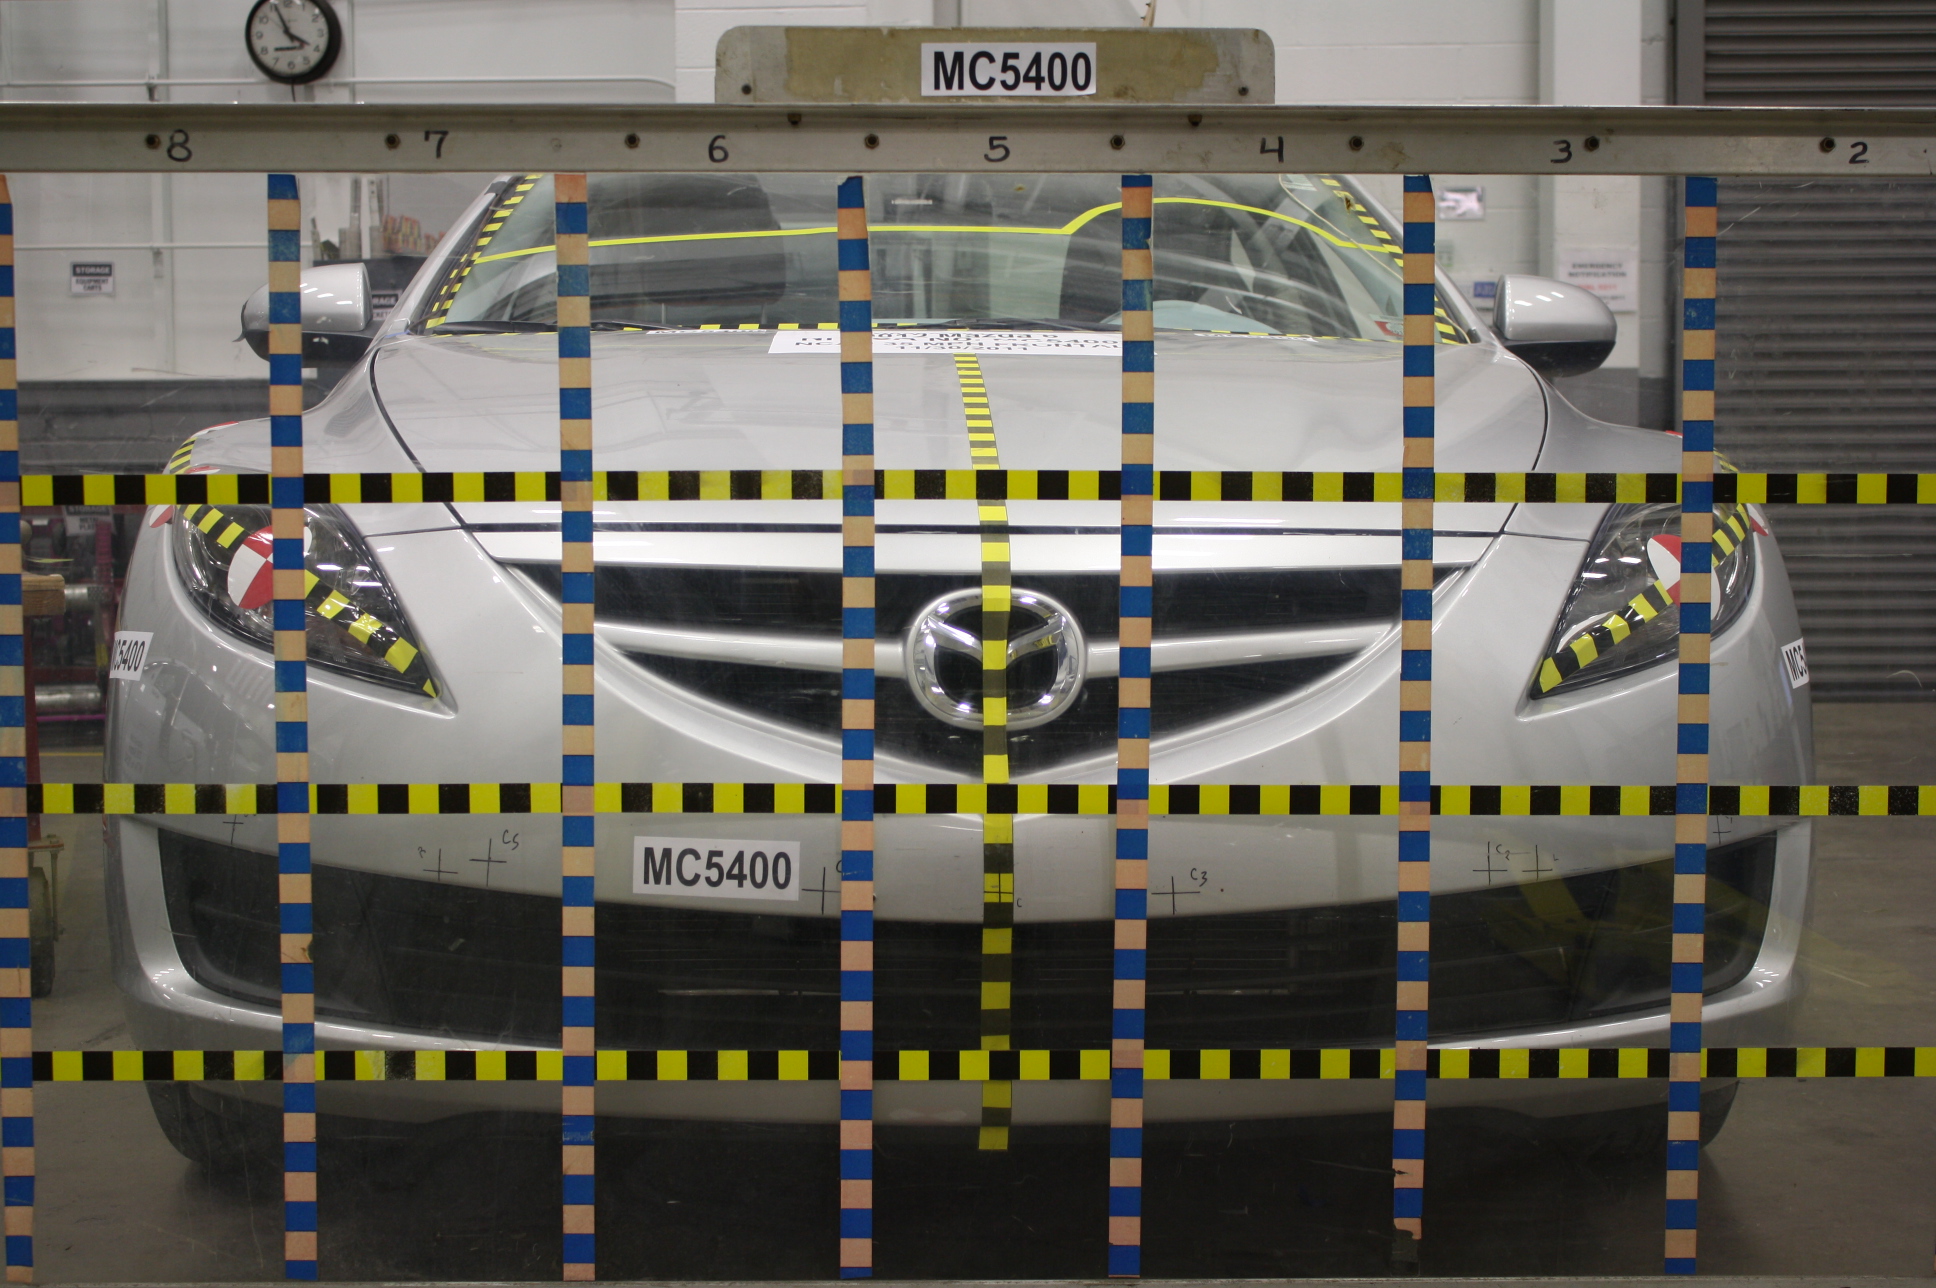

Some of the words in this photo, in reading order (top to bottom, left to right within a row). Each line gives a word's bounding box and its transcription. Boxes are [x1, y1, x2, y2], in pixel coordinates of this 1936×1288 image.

[312, 13, 320, 23] 2
[287, 61, 295, 70] 6
[933, 50, 1092, 92] MC5400
[166, 129, 192, 162] 8
[424, 130, 449, 159] 7
[707, 133, 729, 163] 6
[983, 135, 1010, 162] 5
[1259, 136, 1284, 163] 4
[1550, 139, 1572, 164] 3
[1848, 141, 1870, 164] 2
[75, 266, 111, 275] STORAGE
[643, 846, 792, 890] MC5400
[1190, 867, 1208, 887] C3
